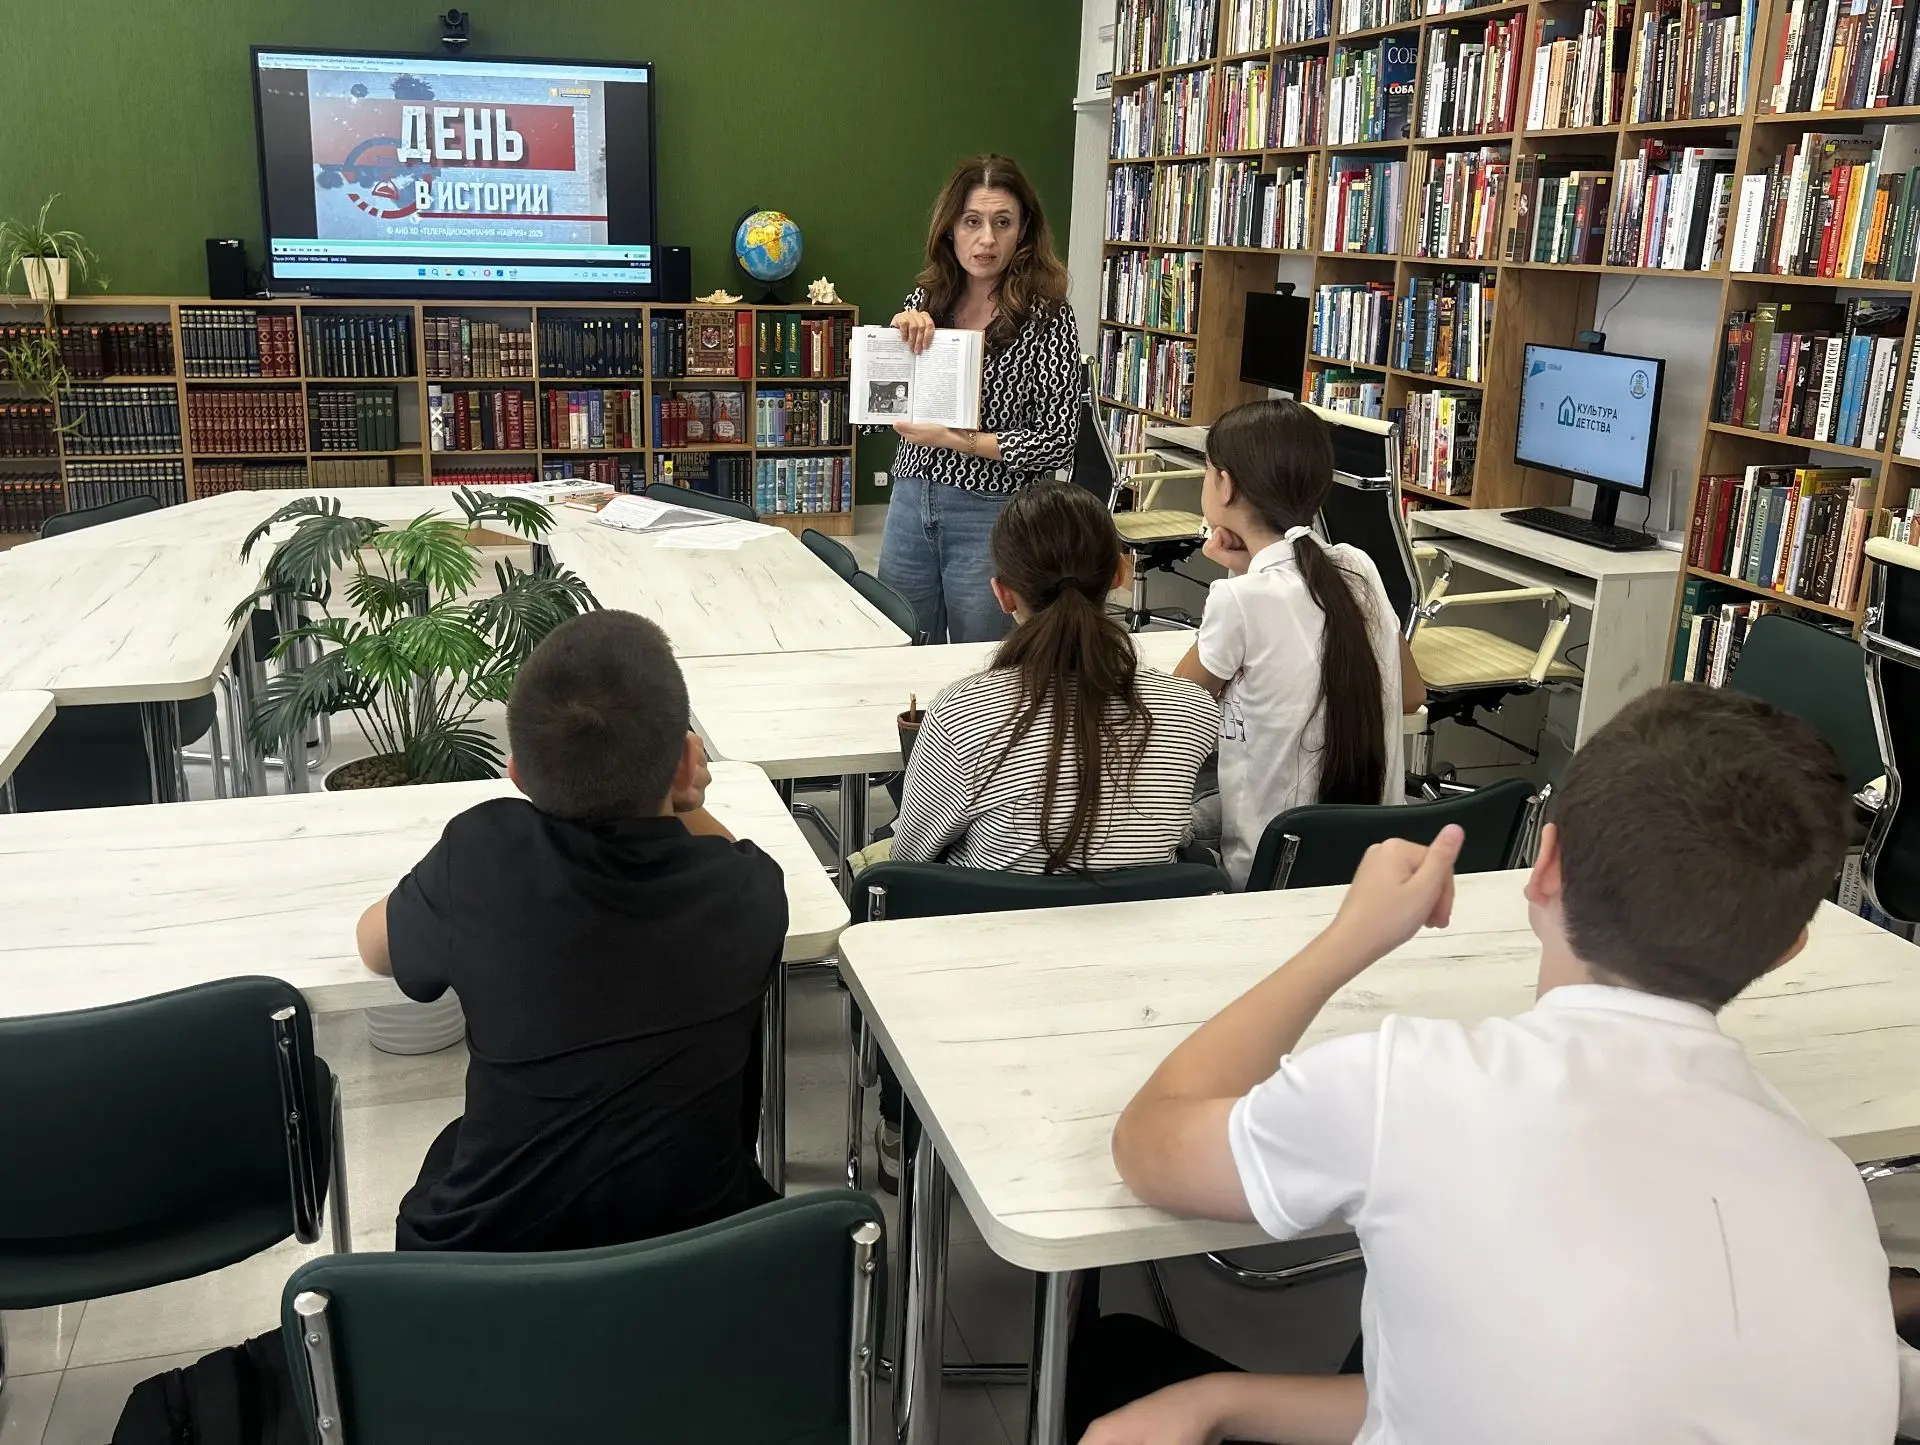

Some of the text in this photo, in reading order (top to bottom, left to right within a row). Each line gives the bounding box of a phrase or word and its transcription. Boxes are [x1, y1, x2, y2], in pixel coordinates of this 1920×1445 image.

[1388, 46, 1418, 65] СОБ
[1710, 24, 1722, 93] КРЕСТОВЫЕ ПОХОДЫ
[1389, 84, 1414, 95] СОБА
[397, 105, 524, 164] ДЕНЬ
[415, 181, 549, 213] В ИСТОРИИ
[1826, 342, 1838, 367] РОССИИ
[1820, 375, 1834, 408] РАЗДУМЬЯ
[1577, 403, 1618, 421] КУЛЬТУРА
[1575, 418, 1611, 434] ДЕТСТВА
[672, 452, 710, 465] ГИННЕСС
